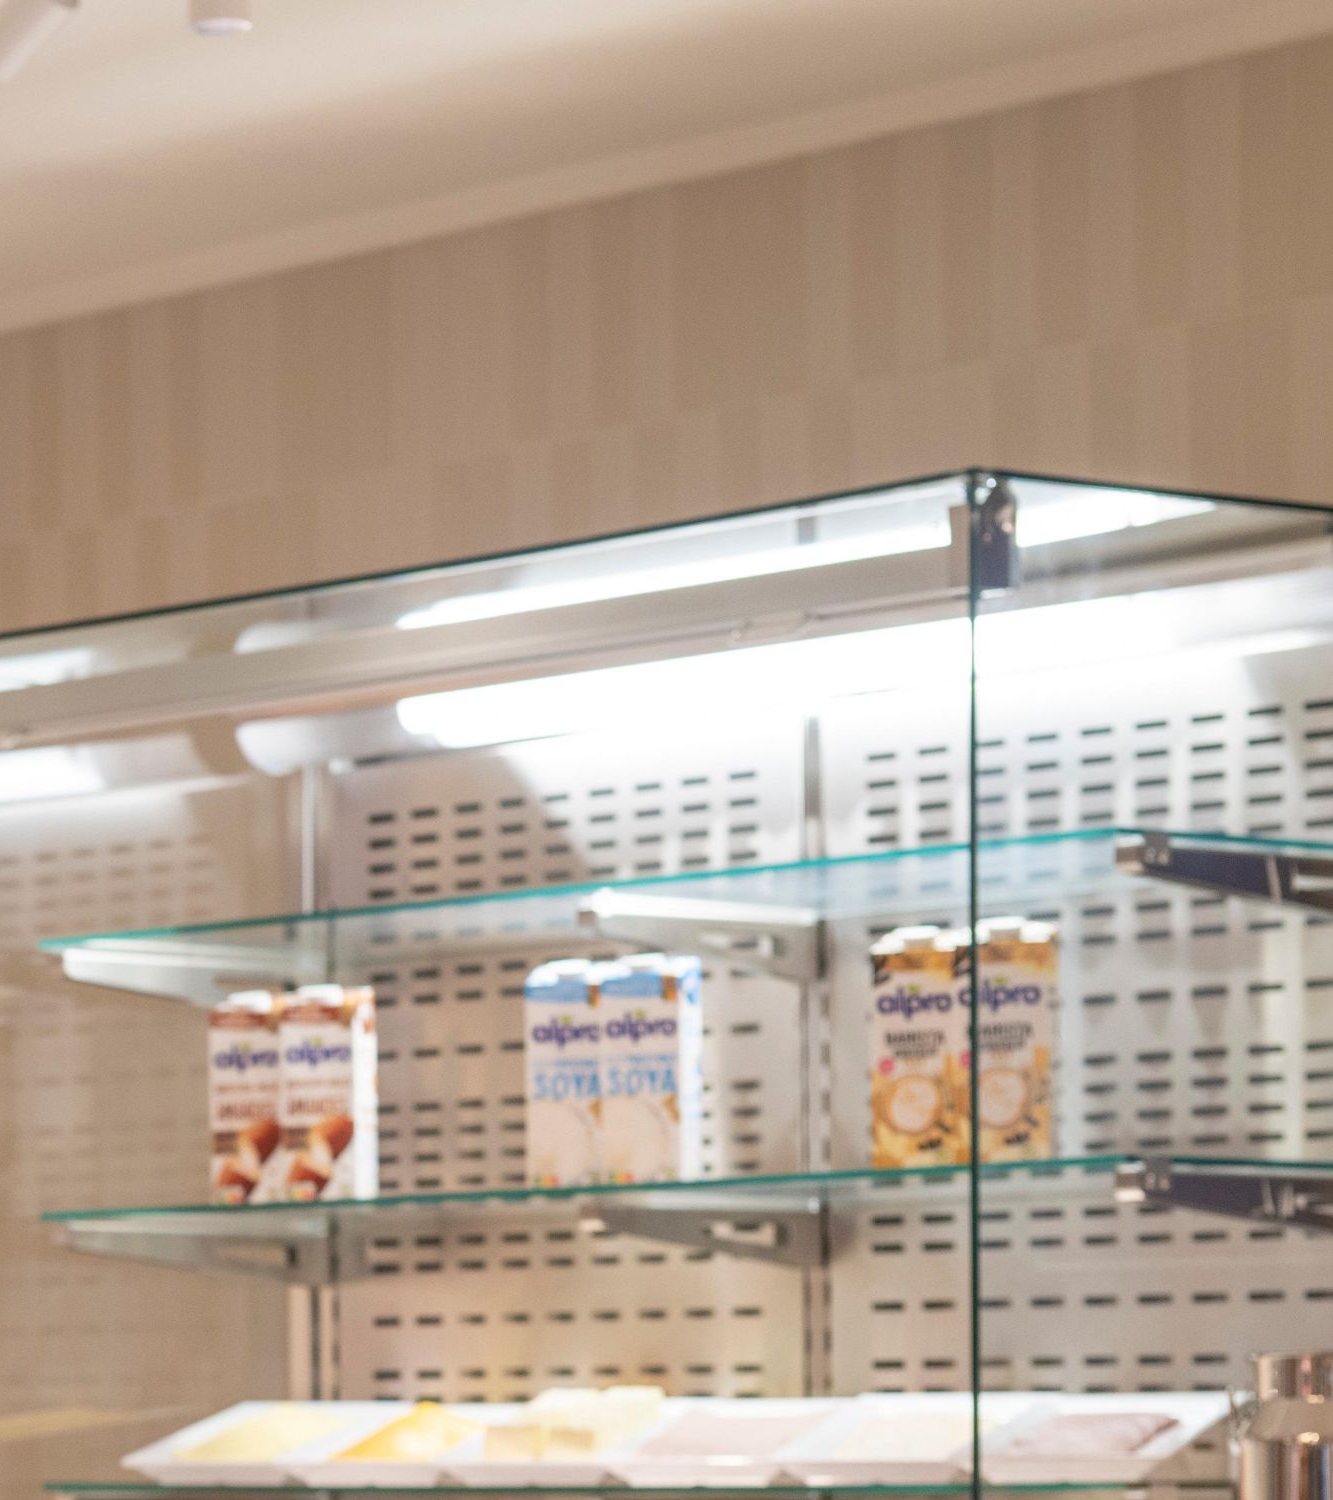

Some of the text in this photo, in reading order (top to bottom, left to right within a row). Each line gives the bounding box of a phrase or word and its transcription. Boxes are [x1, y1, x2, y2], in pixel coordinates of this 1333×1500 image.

[877, 983, 953, 1018] alpro
[606, 1012, 677, 1042] alpro
[608, 1067, 677, 1095] SOYA
